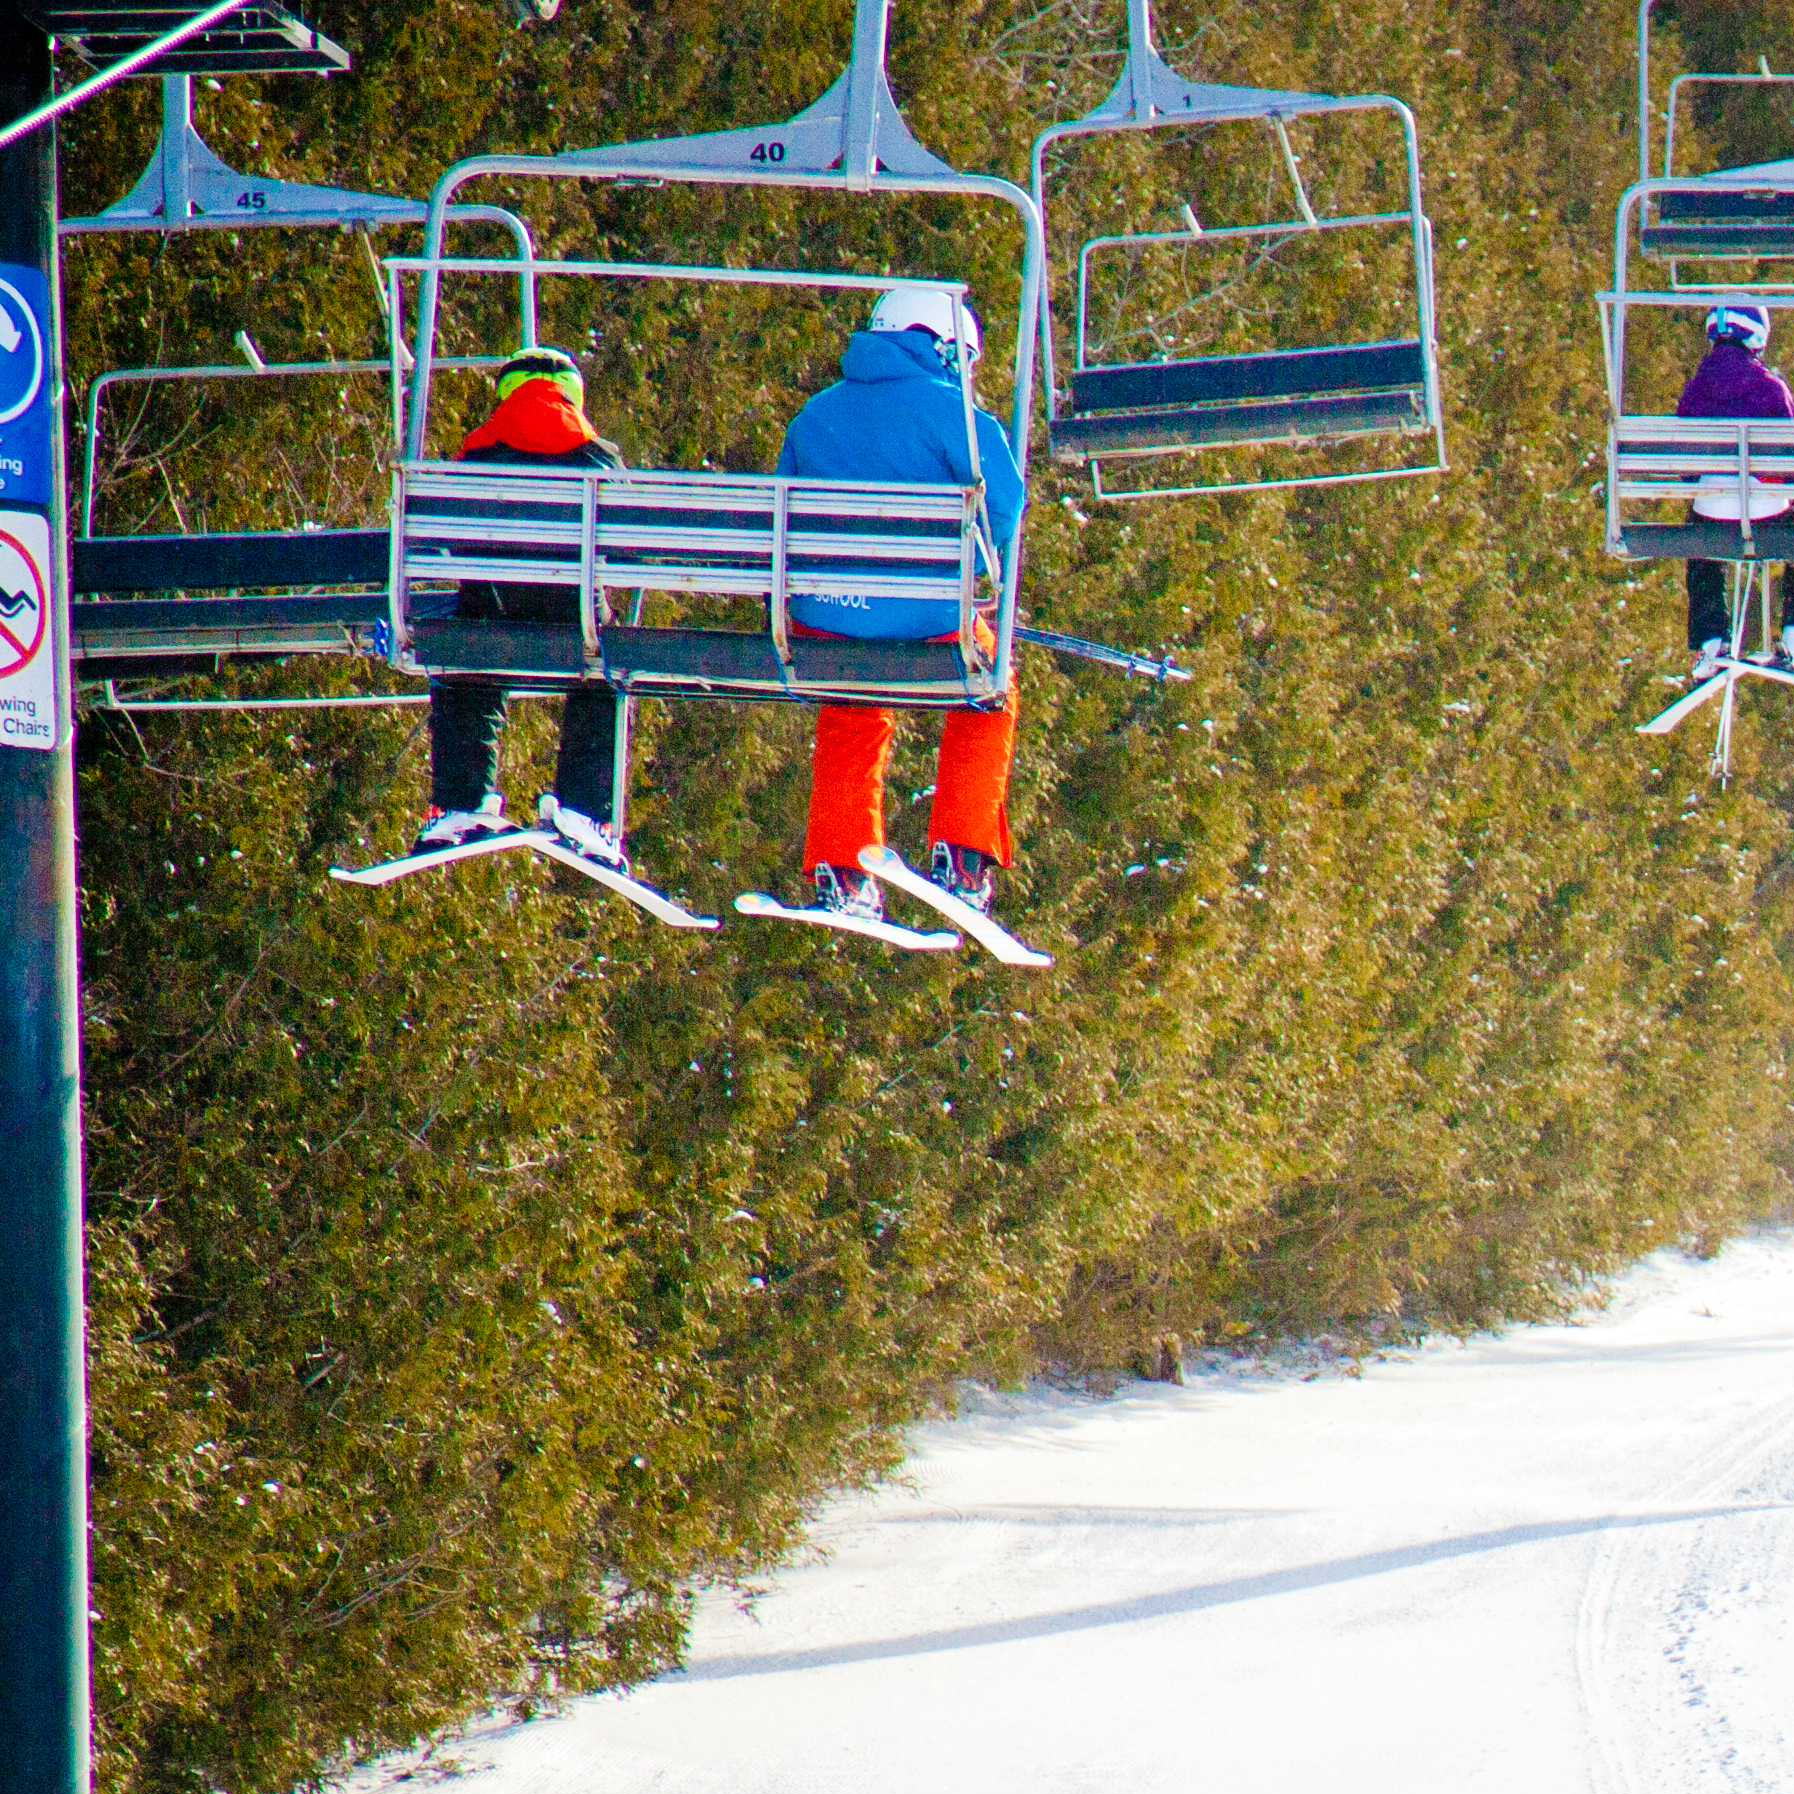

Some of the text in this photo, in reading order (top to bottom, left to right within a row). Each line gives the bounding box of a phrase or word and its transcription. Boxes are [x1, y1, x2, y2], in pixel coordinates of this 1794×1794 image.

[750, 141, 787, 163] 40
[236, 191, 267, 209] 45
[3, 717, 50, 738] Chairs
